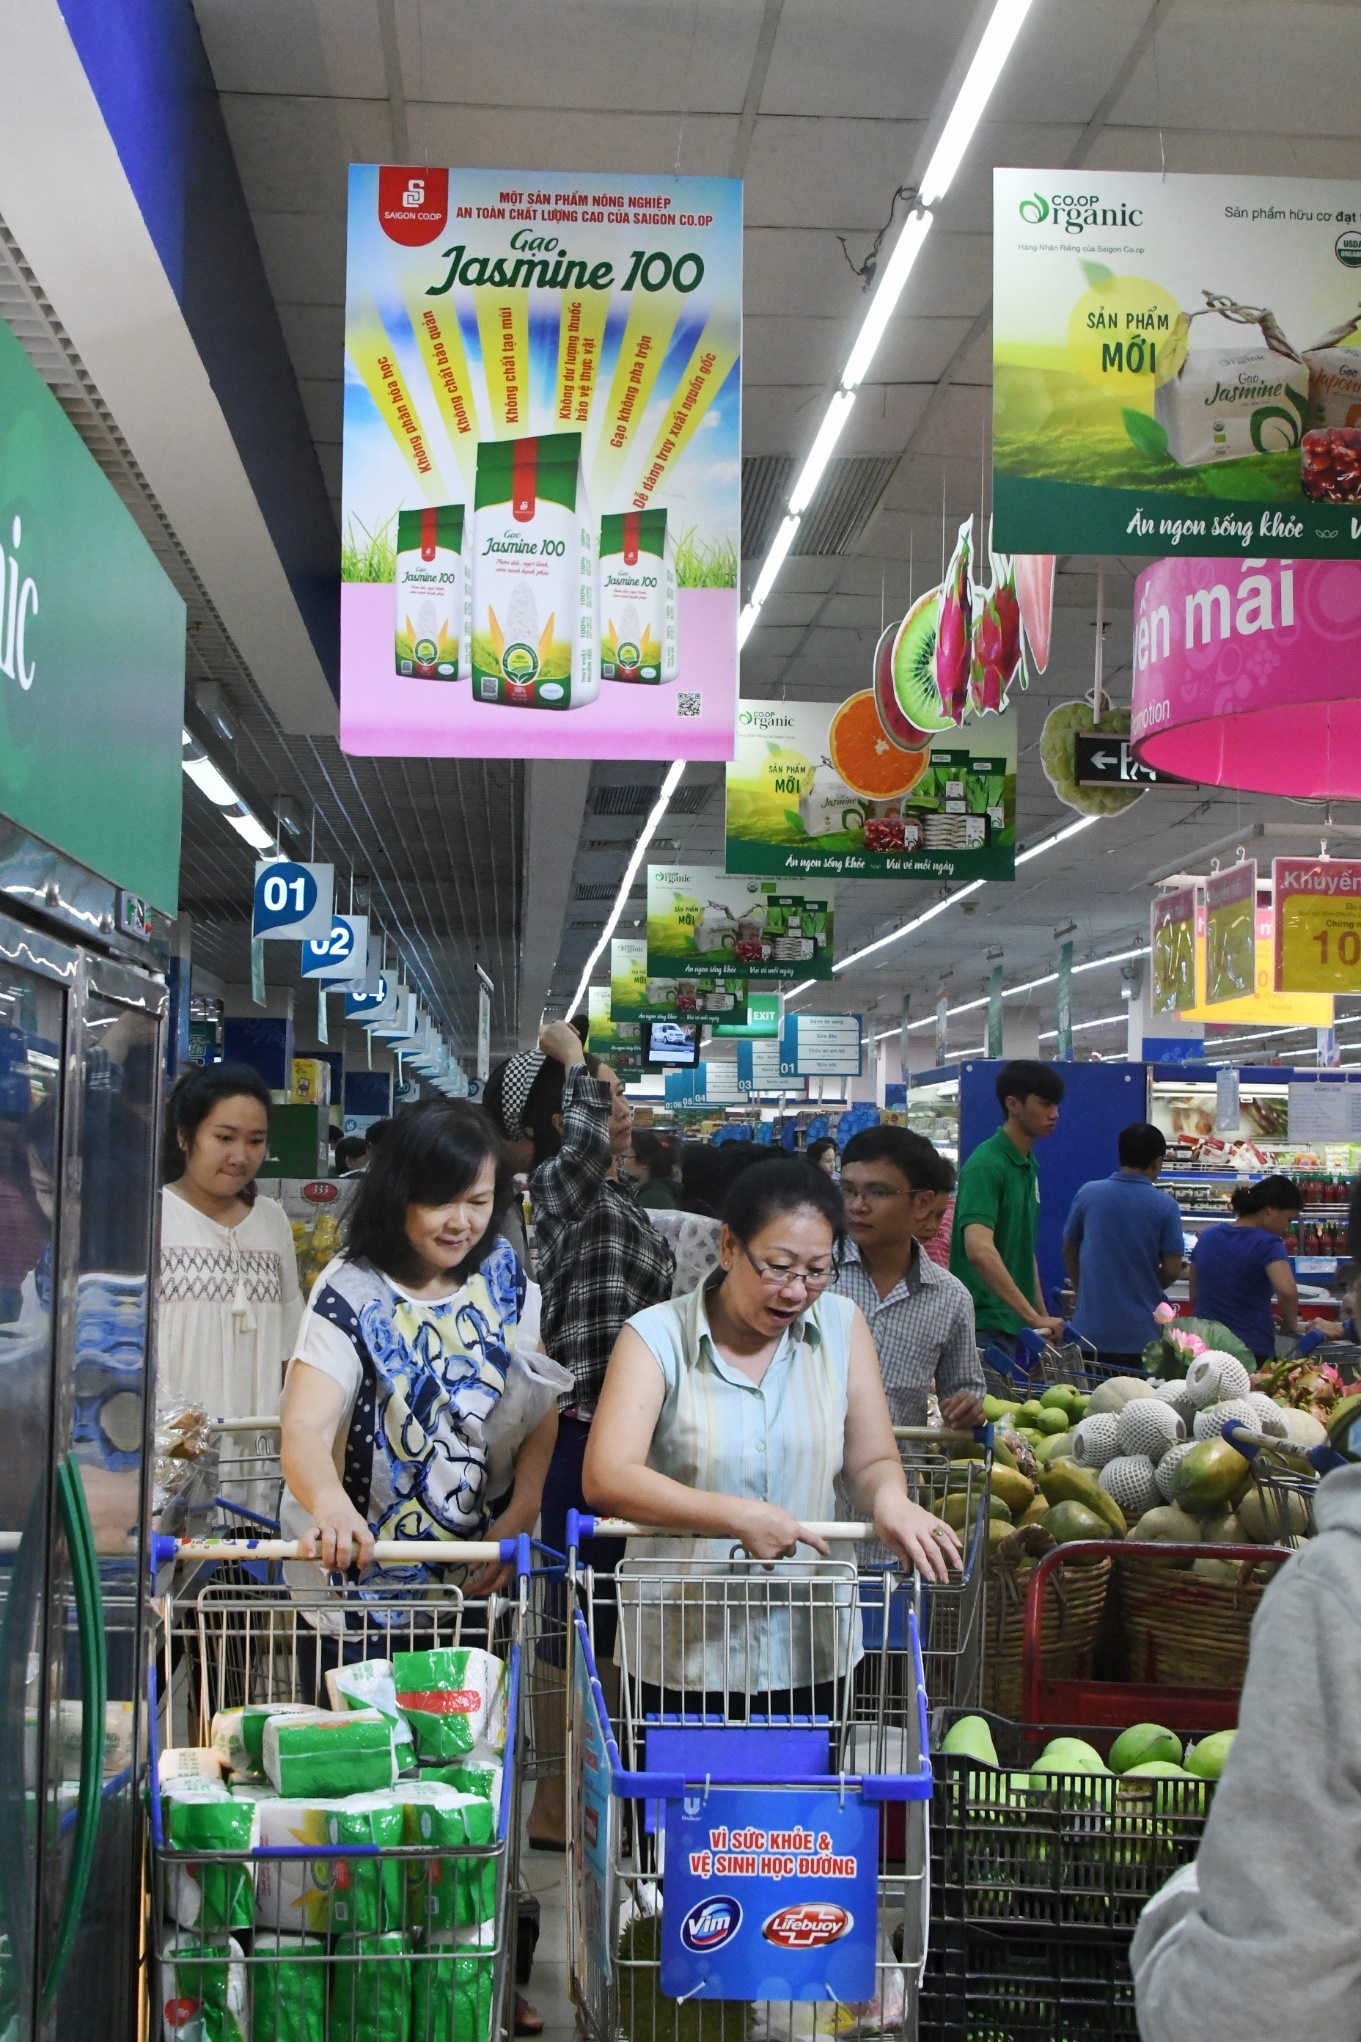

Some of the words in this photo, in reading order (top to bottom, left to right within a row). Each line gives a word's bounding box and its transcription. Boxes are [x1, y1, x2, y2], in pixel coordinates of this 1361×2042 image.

[499, 191, 524, 206] MỘT
[527, 190, 551, 205] SẢN
[554, 190, 588, 206] PHẨM
[592, 193, 625, 208] NÔNG
[628, 195, 671, 211] NGHIỆP
[1051, 194, 1100, 207] CO.OP
[384, 211, 416, 220] SAIGON
[456, 206, 473, 219] AN
[476, 205, 506, 220] TOÀN
[509, 205, 538, 221] CHẤT
[541, 208, 578, 224] LƯỢNG
[581, 210, 605, 223] CAO
[607, 208, 630, 224] CỦA
[633, 212, 676, 226] SAIGON
[679, 214, 713, 227] CO.OP
[1224, 206, 1249, 218] Sản
[1252, 205, 1286, 221] phẩm
[1289, 208, 1313, 221] hữu
[1316, 211, 1332, 222] cơ
[1335, 211, 1357, 225] đạt
[509, 228, 559, 257] Gạo
[1097, 245, 1122, 254] Saigon
[425, 245, 616, 295] Jasmine
[620, 250, 705, 293] 100
[498, 306, 513, 330] mùi
[567, 301, 582, 333] thuốc
[1086, 306, 1119, 330] SẢN
[1125, 305, 1170, 331] PHẨM
[502, 333, 517, 353] tạo
[564, 335, 580, 366] lượng
[634, 335, 652, 359] trộn
[1101, 333, 1156, 374] MỚI
[377, 356, 394, 380] học
[437, 366, 458, 393] chất
[500, 355, 516, 382] chất
[629, 360, 645, 384] pha
[1238, 372, 1259, 385] Gạo
[1339, 364, 1358, 377] Gạo
[504, 385, 519, 424] Không
[558, 385, 575, 420] Không
[617, 384, 640, 423] không
[1204, 379, 1283, 406] Jasmine
[397, 404, 418, 435] phân
[450, 395, 471, 434] Không
[575, 401, 589, 422] bảo
[610, 424, 628, 448] Gạo
[632, 491, 649, 509] Dễ
[642, 462, 665, 492] dàng
[655, 438, 677, 462] truy
[668, 410, 689, 438] xuất
[681, 375, 706, 412] nguồn
[698, 352, 717, 376] gốc
[409, 434, 432, 474] Không
[1126, 508, 1154, 537] Ăn
[1159, 515, 1206, 546] ngon
[1210, 512, 1254, 546] sống
[1259, 510, 1304, 538] khỏe
[481, 537, 539, 556] Jasmine
[539, 539, 566, 557] 100
[402, 571, 438, 584] Jasmine
[438, 573, 455, 584] 100
[604, 575, 640, 588] Jasmine
[640, 576, 658, 588] 100
[1185, 558, 1294, 650] mãi
[775, 775, 800, 794] MỚI
[799, 858, 821, 872] ngon
[886, 858, 901, 870] Vui
[263, 876, 306, 912] 01
[753, 1011, 776, 1021] EXIT
[780, 1062, 795, 1074] 01
[738, 1080, 752, 1090] 03
[673, 1101, 683, 1109] 06
[682, 1097, 693, 1106] 05
[695, 1094, 706, 1103] 04
[710, 1827, 728, 1849] VÌ
[732, 1827, 765, 1850] SỨC
[769, 1826, 814, 1851] KHỎE
[817, 1832, 832, 1851] &
[690, 1852, 712, 1879] VỆ
[715, 1854, 757, 1876] SINH
[760, 1855, 794, 1880] HỌC
[798, 1850, 856, 1878] ĐƯỜNG
[688, 1912, 731, 1936] Vim
[771, 1917, 843, 1936] Lifebuoy
